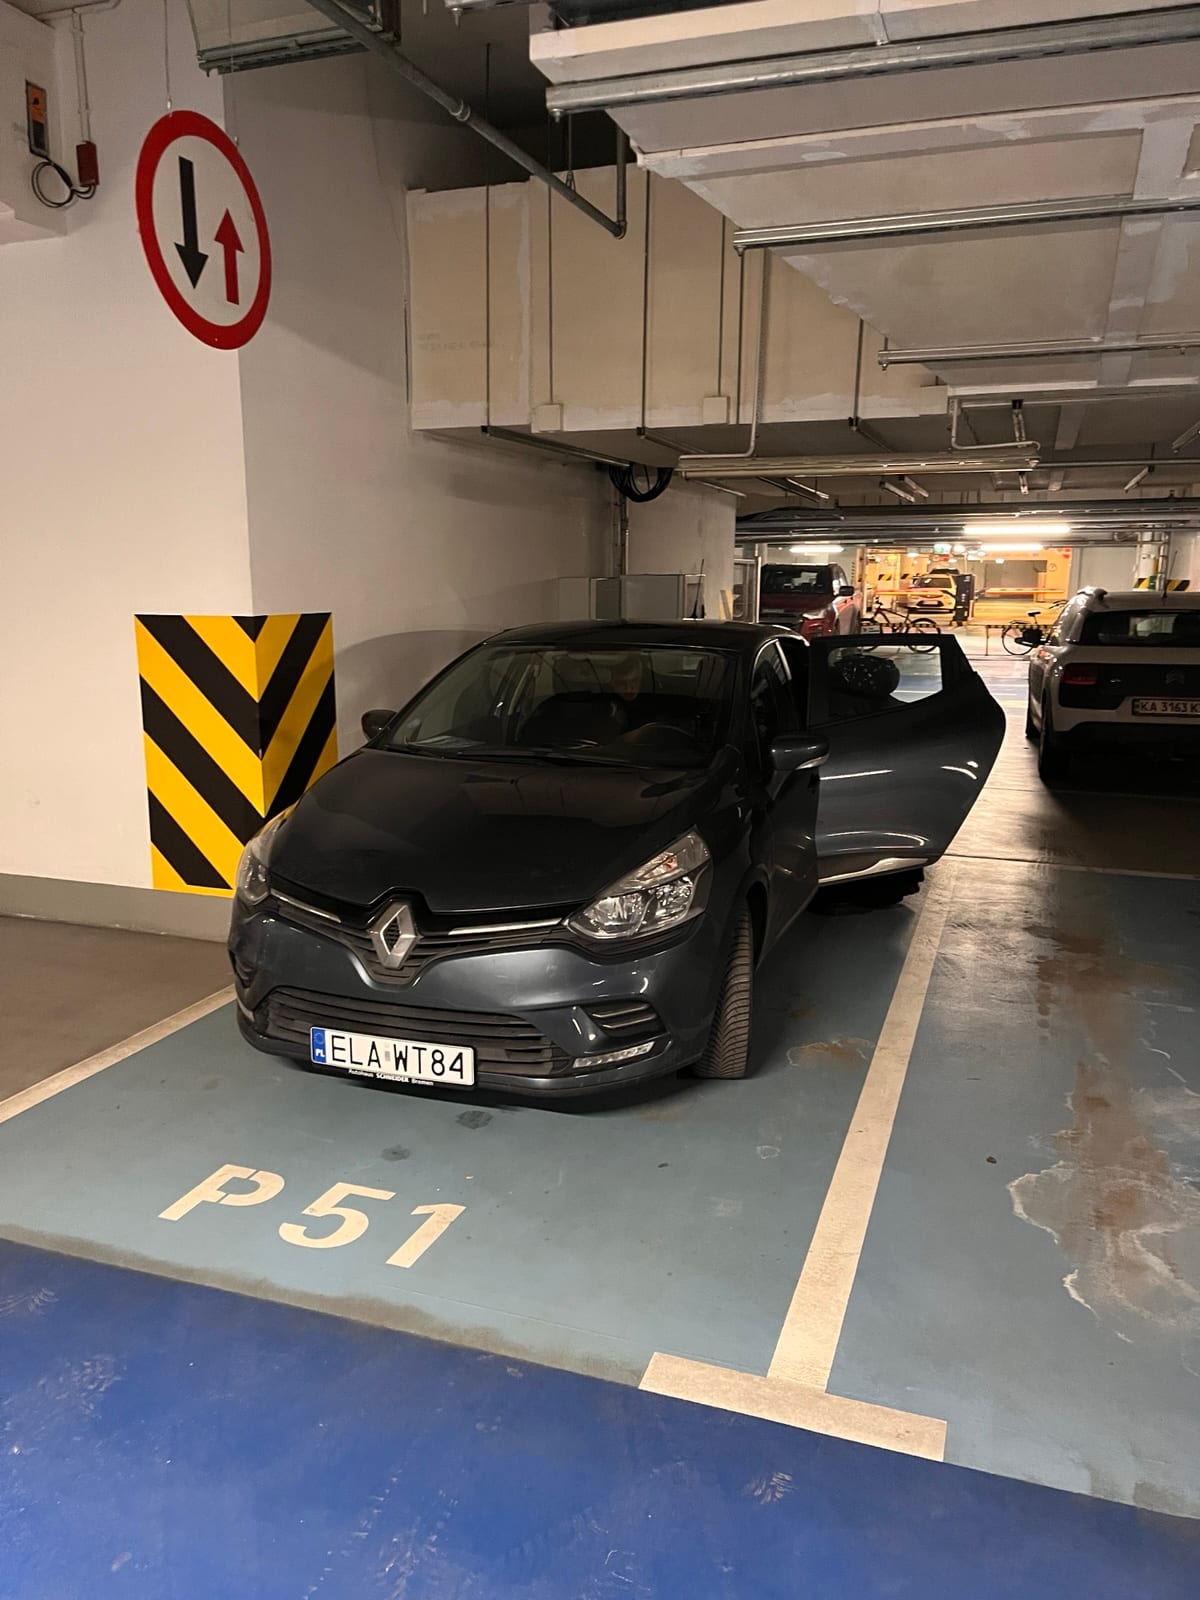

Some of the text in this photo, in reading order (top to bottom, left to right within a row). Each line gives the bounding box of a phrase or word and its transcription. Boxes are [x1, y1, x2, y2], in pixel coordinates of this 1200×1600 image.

[1140, 701, 1157, 711] KA
[315, 1048, 325, 1058] PL
[331, 1035, 464, 1079] ELA WT84
[375, 1072, 410, 1083] SCHNEIDER
[411, 1078, 434, 1087] Bremen
